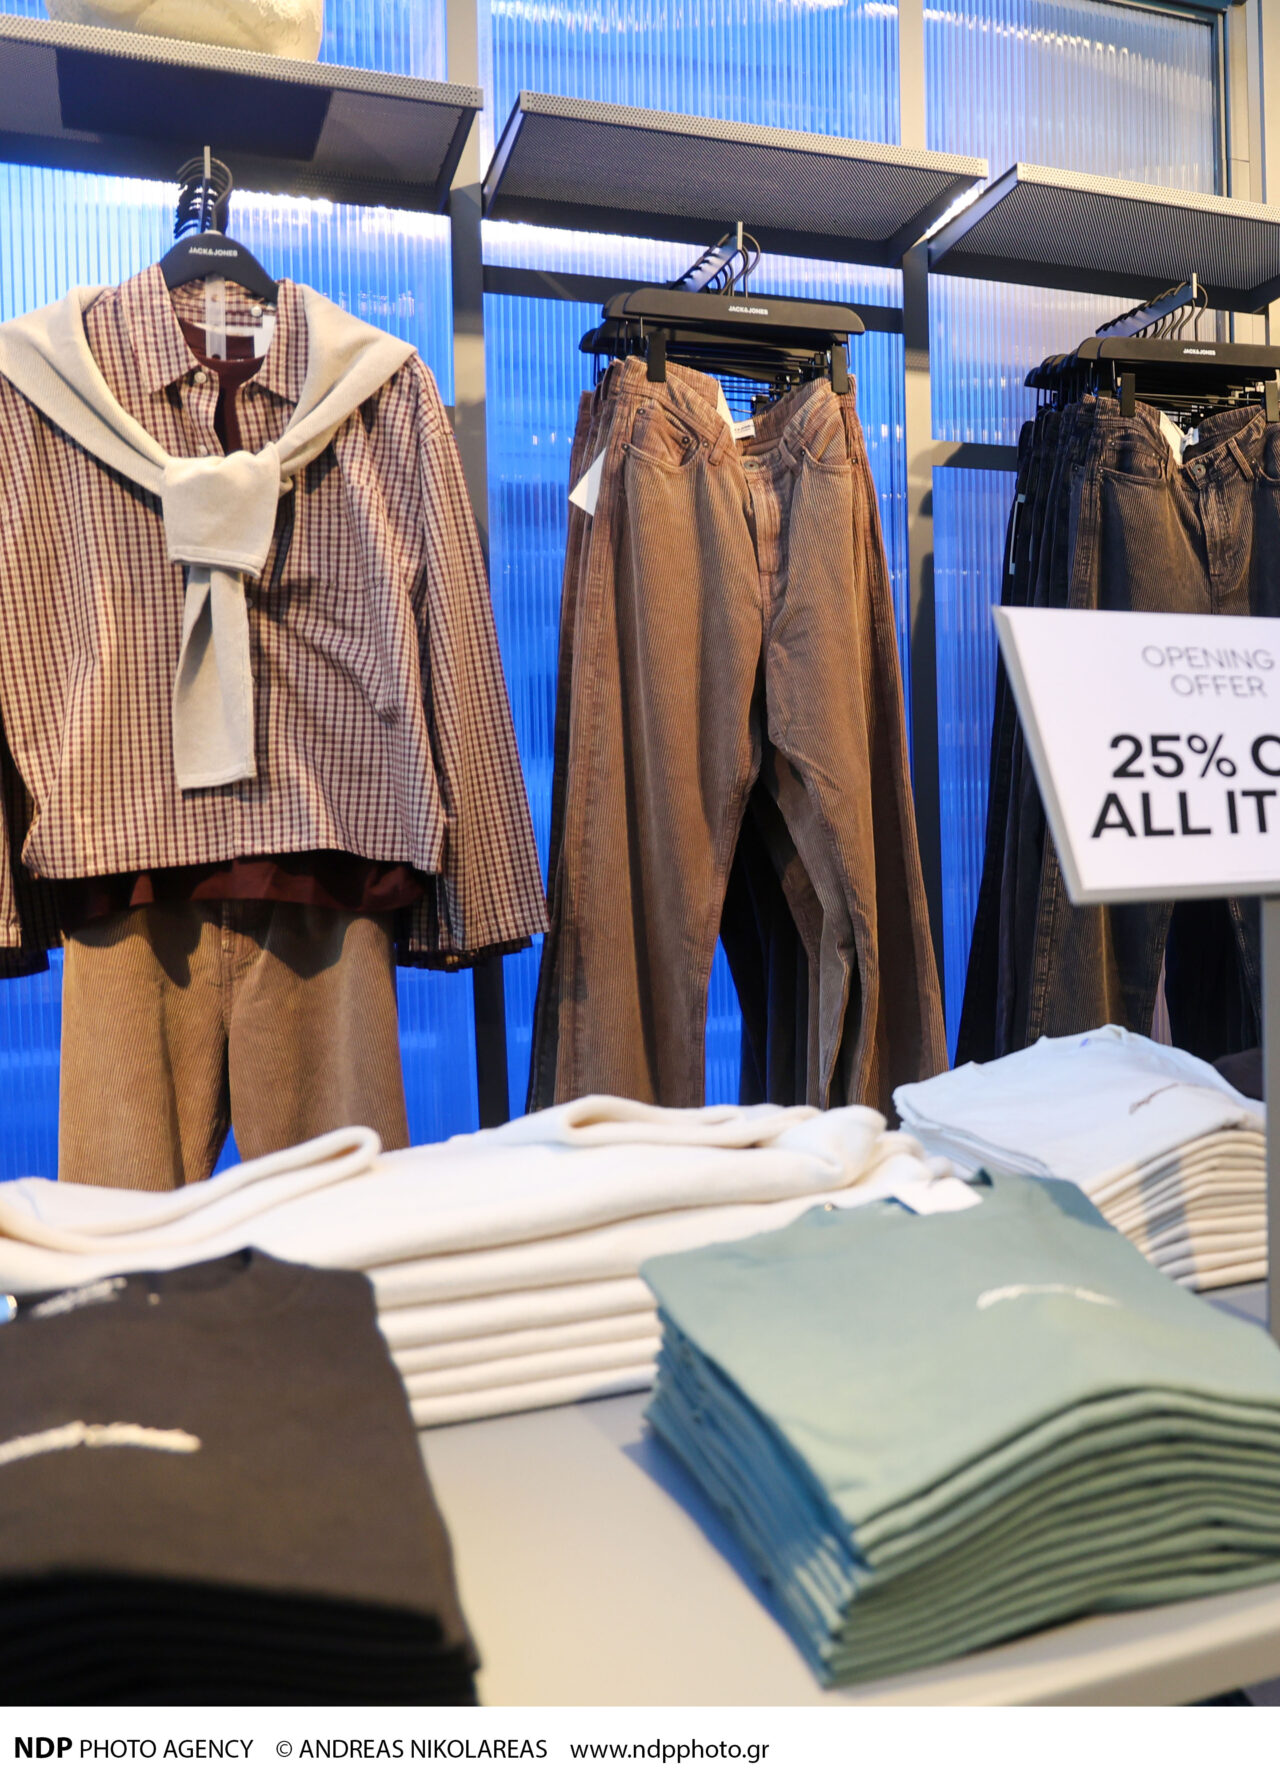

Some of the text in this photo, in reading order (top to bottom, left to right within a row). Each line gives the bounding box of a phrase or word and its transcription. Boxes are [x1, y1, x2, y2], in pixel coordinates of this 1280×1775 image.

[1141, 645, 1276, 670] OPENING
[1170, 674, 1267, 698] OFFER
[1109, 733, 1238, 779] 25%
[1091, 791, 1212, 839] ALL
